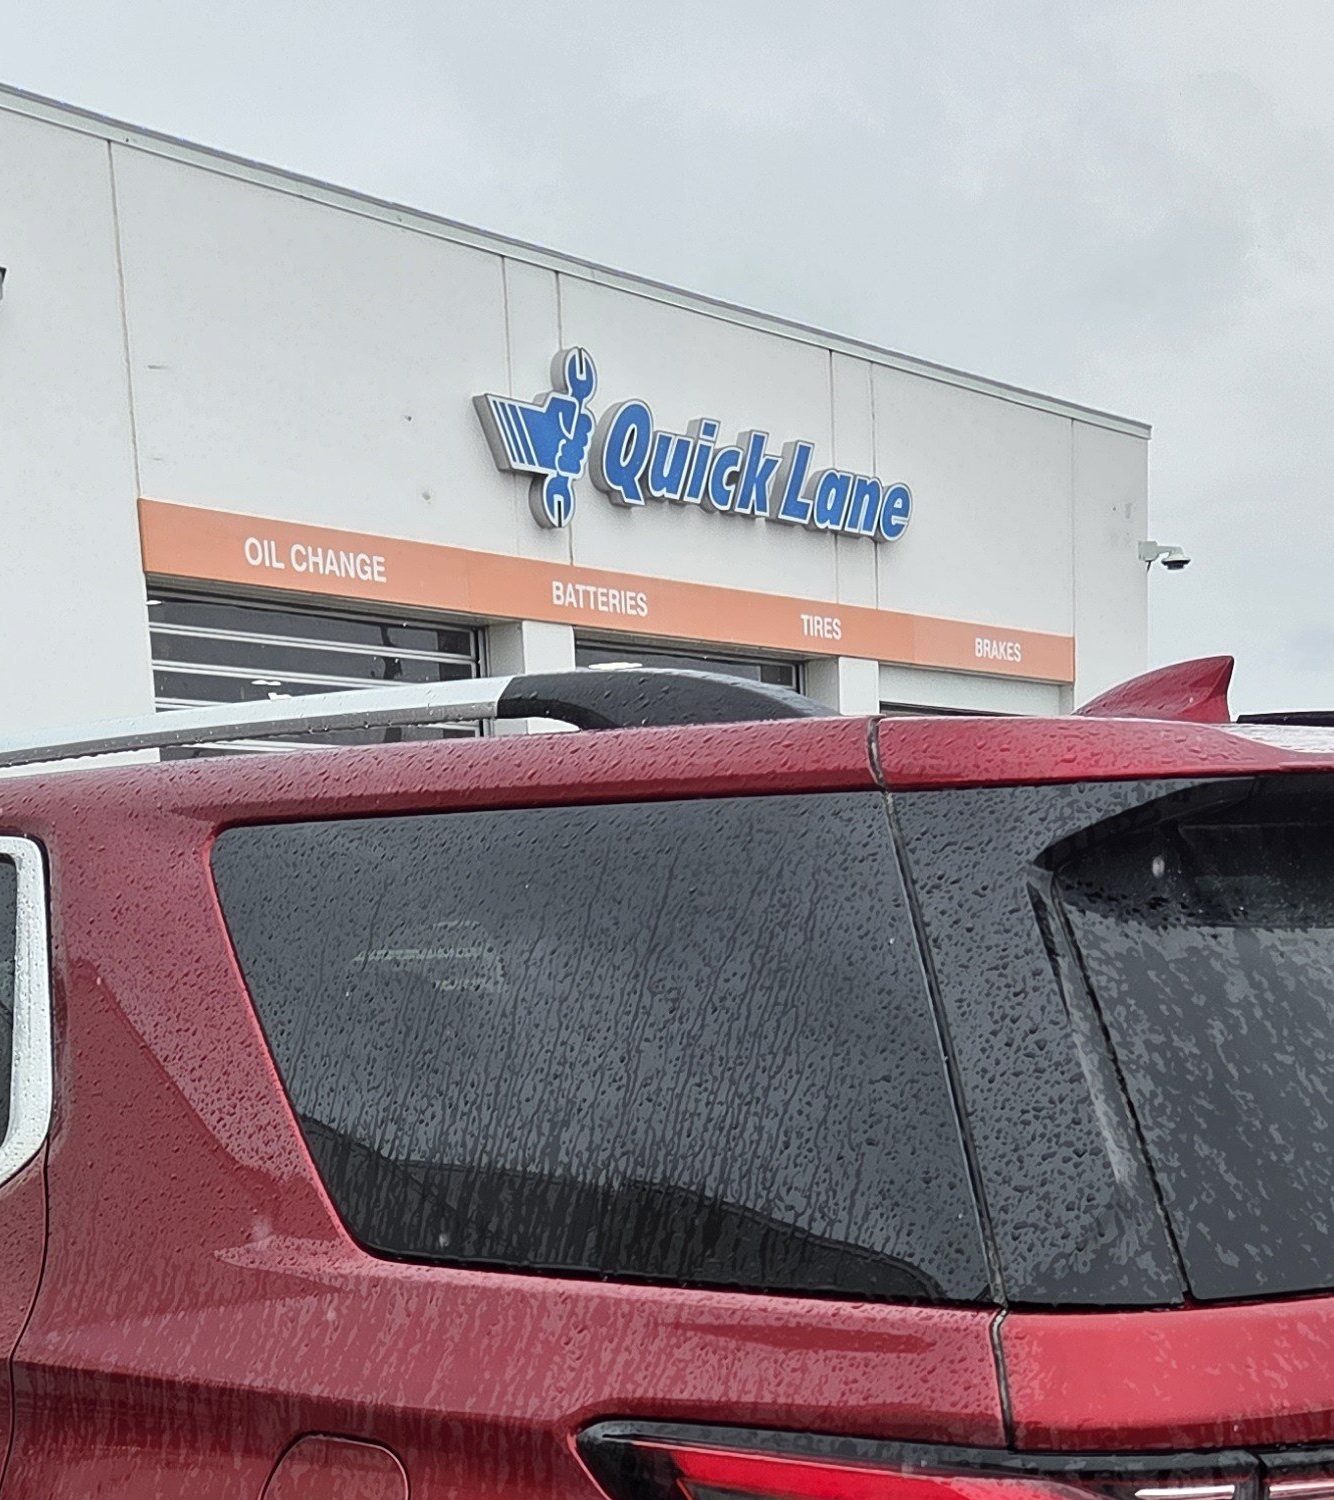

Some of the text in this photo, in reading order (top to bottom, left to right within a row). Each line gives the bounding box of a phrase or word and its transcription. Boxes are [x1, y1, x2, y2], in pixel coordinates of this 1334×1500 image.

[597, 398, 913, 543] Quick Lane
[244, 537, 387, 583] OIL CHANGE
[552, 582, 648, 616] BATTERIES
[800, 613, 842, 640] TIRES
[975, 637, 1021, 663] BRAKES
